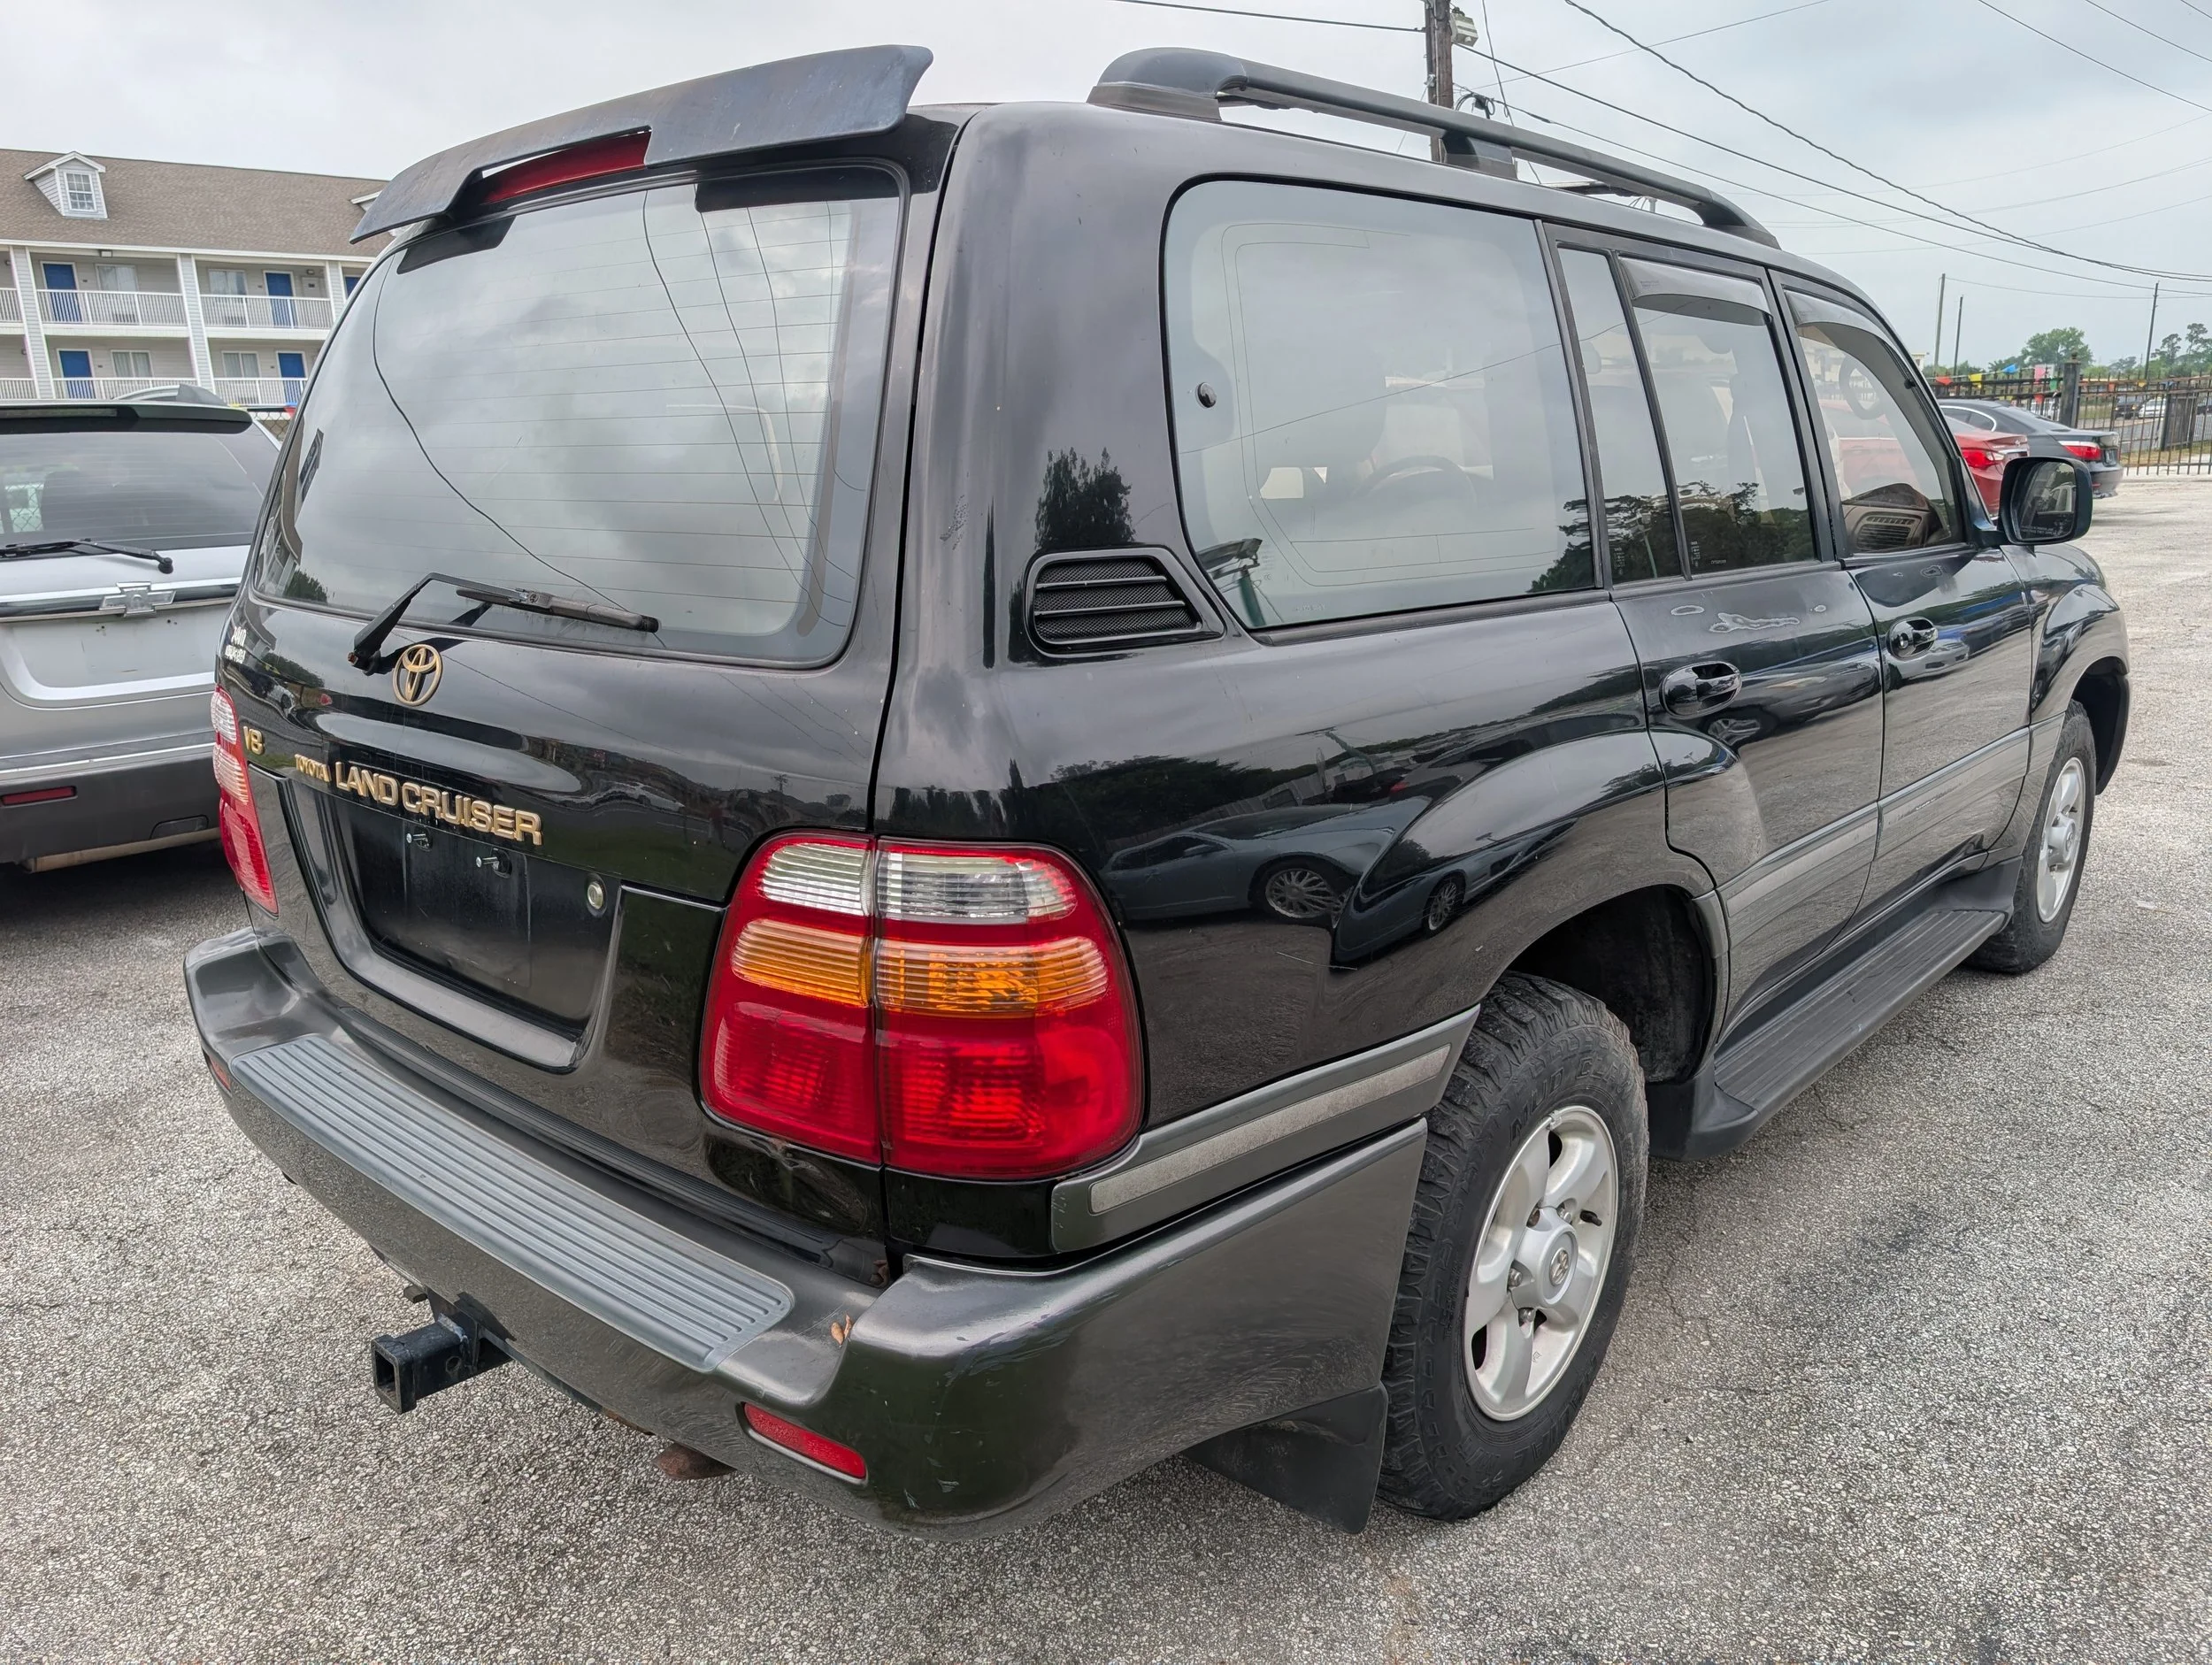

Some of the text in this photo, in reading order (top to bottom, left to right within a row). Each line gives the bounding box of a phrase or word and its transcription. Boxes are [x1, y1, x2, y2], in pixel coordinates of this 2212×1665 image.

[243, 725, 265, 755] V8
[295, 754, 541, 846] TOYOTA LAND CRUISER
